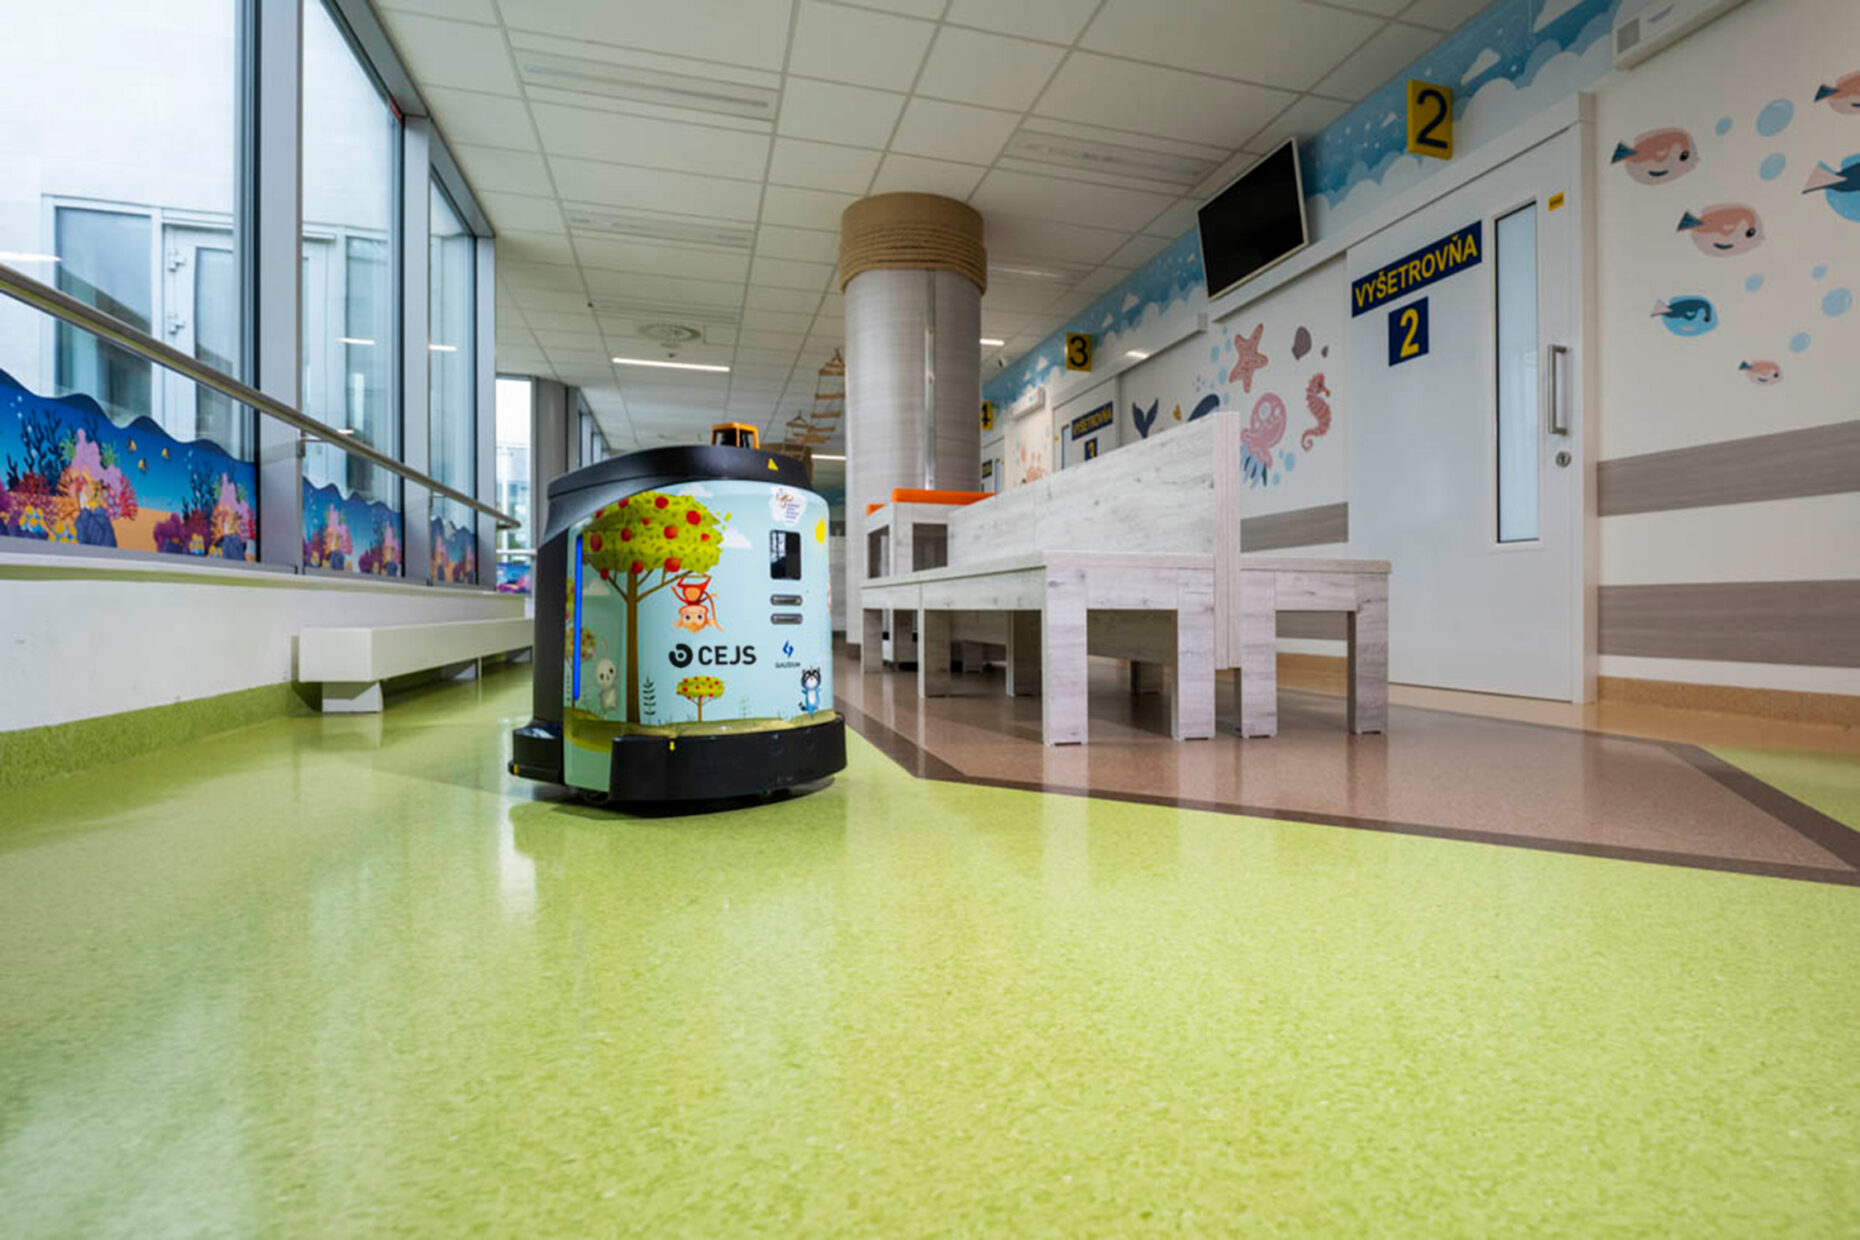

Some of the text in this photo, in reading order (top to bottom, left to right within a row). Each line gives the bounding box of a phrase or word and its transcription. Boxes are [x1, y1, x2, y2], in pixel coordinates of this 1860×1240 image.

[1416, 89, 1448, 149] 2
[1355, 234, 1478, 308] VYŠETROVŇA
[1069, 335, 1089, 368] 3
[1400, 308, 1420, 358] 2
[698, 645, 757, 666] CEJS
